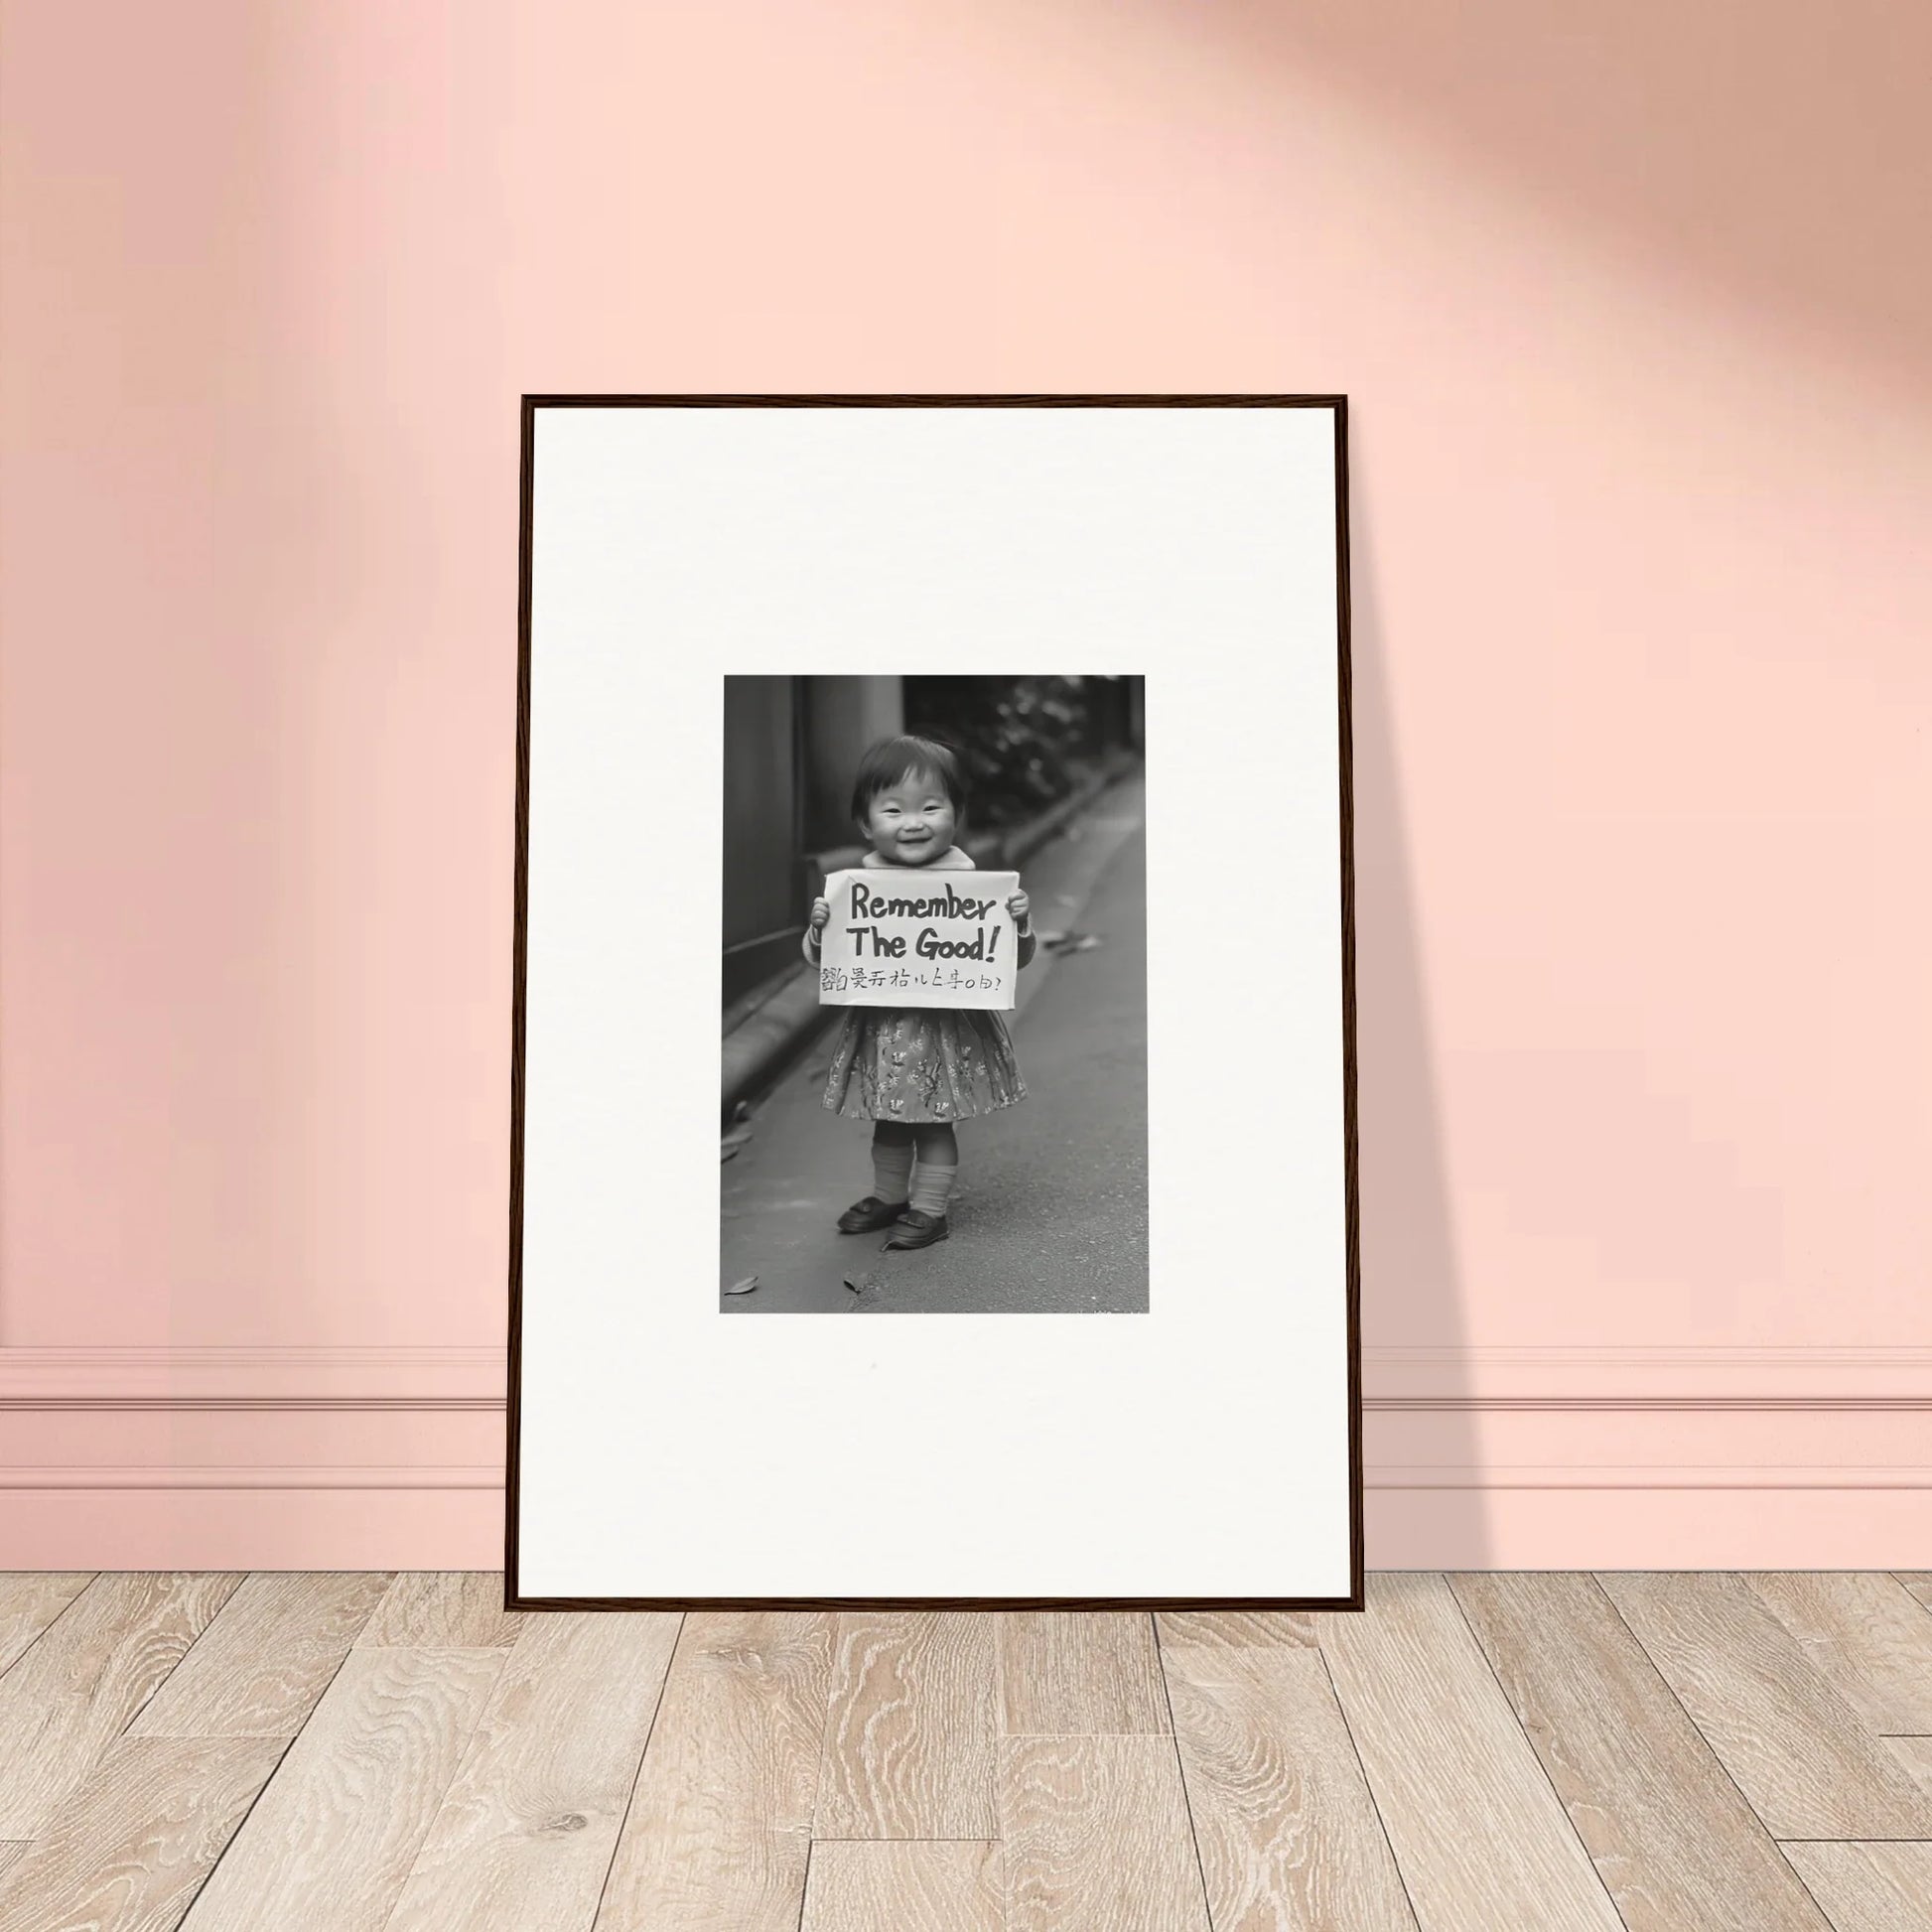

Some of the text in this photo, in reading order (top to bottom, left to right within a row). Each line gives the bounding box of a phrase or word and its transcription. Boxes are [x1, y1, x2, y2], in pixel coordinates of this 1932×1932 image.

[851, 883, 997, 920] Remember
[846, 925, 1002, 963] The Good!
